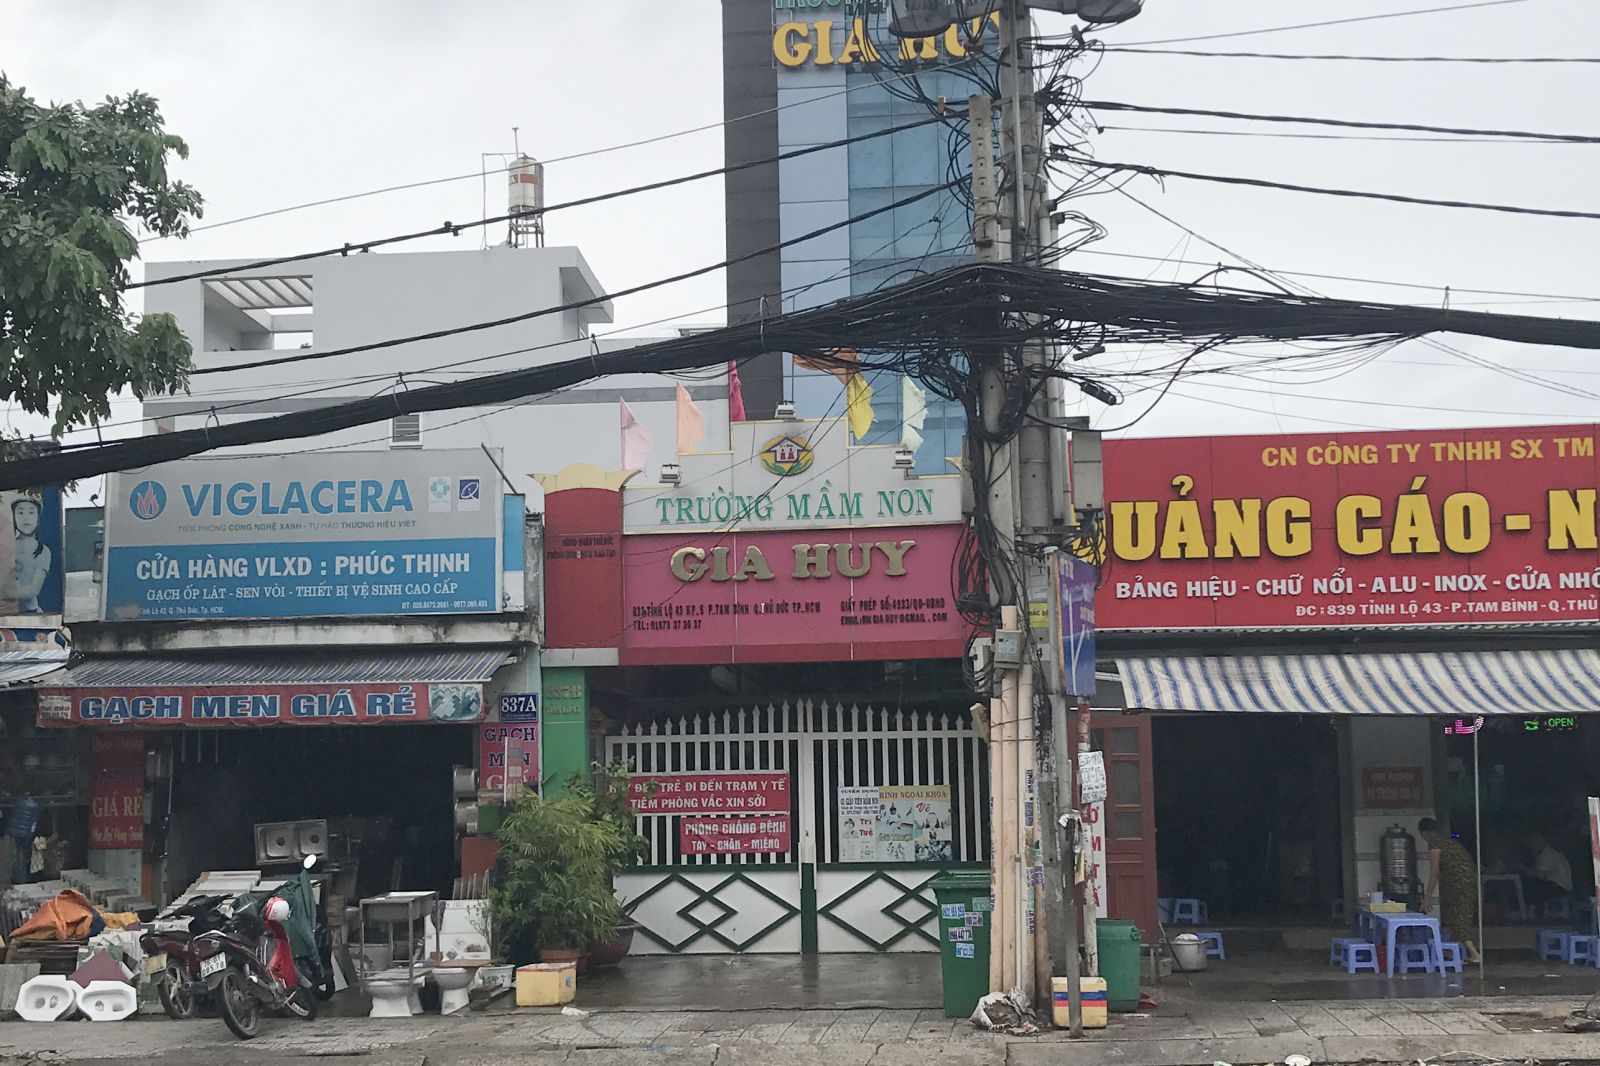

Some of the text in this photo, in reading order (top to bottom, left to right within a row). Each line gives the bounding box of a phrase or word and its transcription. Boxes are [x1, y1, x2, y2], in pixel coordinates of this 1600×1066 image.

[773, 17, 881, 67] GIA
[1262, 437, 1594, 467] CN CÔNG TY TNHH SX TM
[182, 478, 414, 517] VIGLACERA
[655, 479, 934, 524] TRƯỜNG MẦM NON
[279, 522, 302, 531] XANH
[1336, 475, 1492, 554] CÁO
[136, 552, 180, 580] CỬA
[188, 553, 248, 579] HÀNG
[255, 556, 312, 577] VLXD
[335, 550, 395, 576] PHÚC
[402, 553, 470, 578] THỊNH
[671, 540, 916, 582] GIA HUY
[147, 578, 458, 603] GẠCH ỐP LÁT SEN VÒI THIẾT BỊ VỆ SINH CAO CẤP
[1116, 575, 1178, 599] BẢNG
[1186, 576, 1237, 601] HIỆU
[1256, 573, 1304, 596] CHỮ
[1313, 567, 1353, 595] NỔI
[1371, 576, 1417, 593] ALU
[1434, 574, 1488, 592] INOX
[1505, 565, 1552, 591] CỬA
[1360, 599, 1395, 615] TỈNH
[1400, 600, 1418, 617] LỘ
[1502, 597, 1538, 612] BÌNH
[79, 695, 183, 723] GẠCH
[193, 694, 280, 720] MEN
[291, 689, 356, 718] GIÁ
[366, 686, 416, 717] RẺ
[501, 696, 537, 712] 837A
[1548, 718, 1574, 728] OPEN
[685, 781, 697, 792] ĐI
[700, 778, 722, 791] ĐẾN
[726, 780, 757, 793] TRẠM
[761, 780, 767, 790] Y
[771, 776, 786, 790] TẾ
[630, 797, 657, 809] TIÊM
[661, 796, 698, 808] PHÒNG
[726, 797, 744, 807] XIN
[747, 795, 766, 807] SỞI
[685, 819, 786, 835] PHÒNG CHỐNG BỆNH
[691, 838, 780, 851] TAY CHÂN MIỆNG
